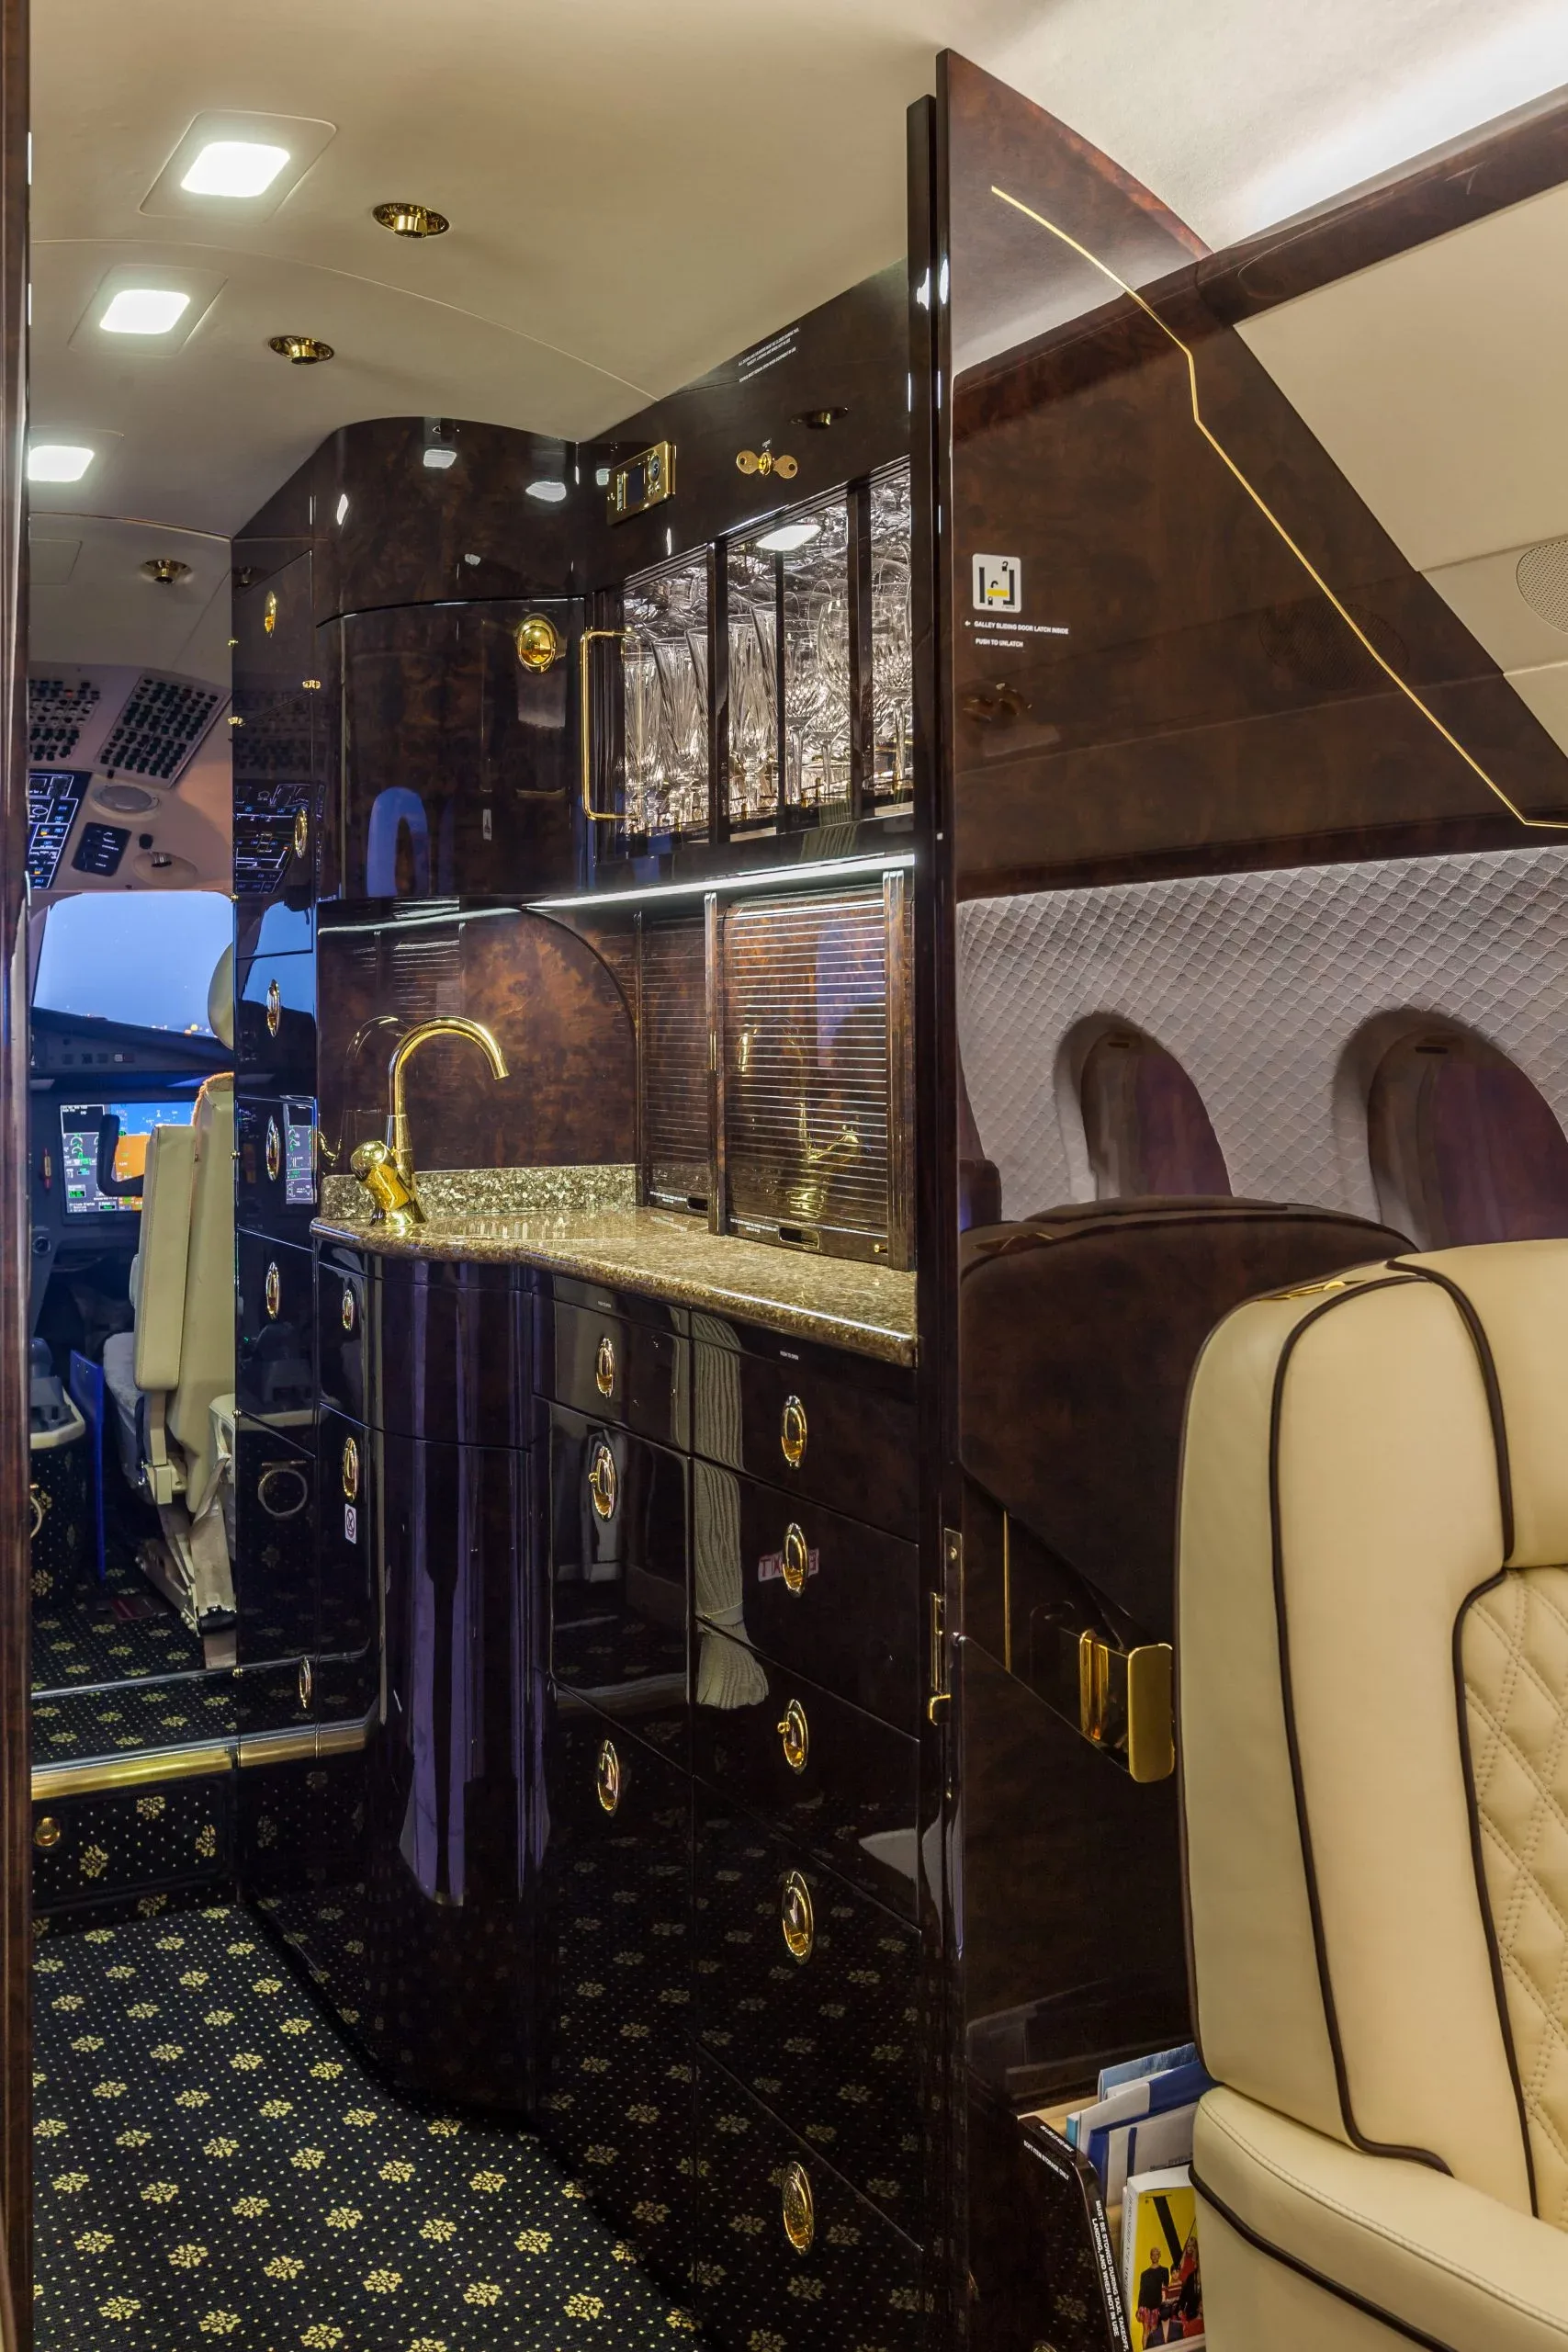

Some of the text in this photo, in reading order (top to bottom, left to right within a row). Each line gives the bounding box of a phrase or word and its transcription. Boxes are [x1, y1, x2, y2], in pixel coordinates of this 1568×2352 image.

[1023, 2140, 1032, 2152] SOFT
[1042, 2154, 1059, 2172] STORAGE
[1059, 2168, 1069, 2180] ONLY
[1096, 2200, 1104, 2221] MUST
[1100, 2222, 1107, 2233] BE
[1102, 2233, 1112, 2265] STOWED
[1092, 2219, 1101, 2253] LANDING,
[1102, 2271, 1111, 2293] WHEN
[1111, 2312, 1116, 2320] IN
[1109, 2267, 1118, 2295] DURING
[1118, 2316, 1129, 2352] TAKEOFF,
